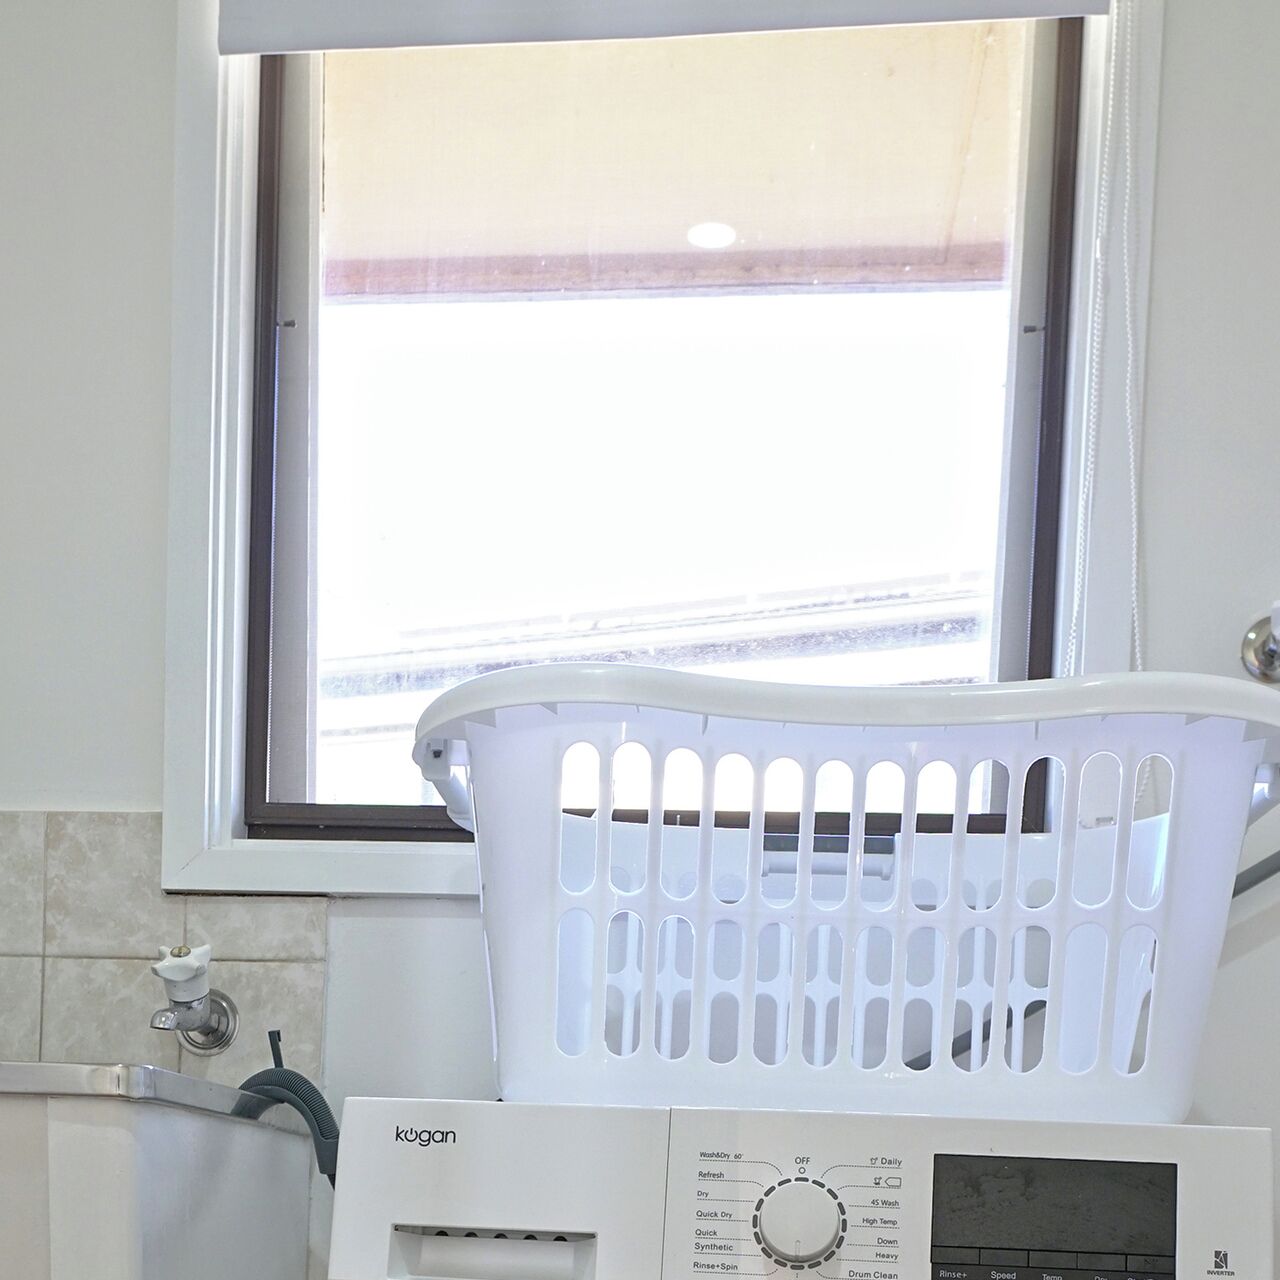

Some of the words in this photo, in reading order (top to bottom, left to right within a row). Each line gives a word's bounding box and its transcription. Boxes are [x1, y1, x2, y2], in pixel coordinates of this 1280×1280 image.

[395, 1126, 456, 1147] kogan
[795, 1156, 810, 1164] OFF
[881, 1157, 902, 1167] Daily
[880, 1218, 898, 1226] Temp
[877, 1237, 898, 1245] Down
[694, 1242, 733, 1251] Synthetic
[876, 1252, 899, 1260] Heavy
[693, 1262, 738, 1271] Rinse+Spin
[849, 1270, 871, 1278] Drum
[939, 1270, 967, 1278] Rinse+
[991, 1271, 1016, 1280] Speed
